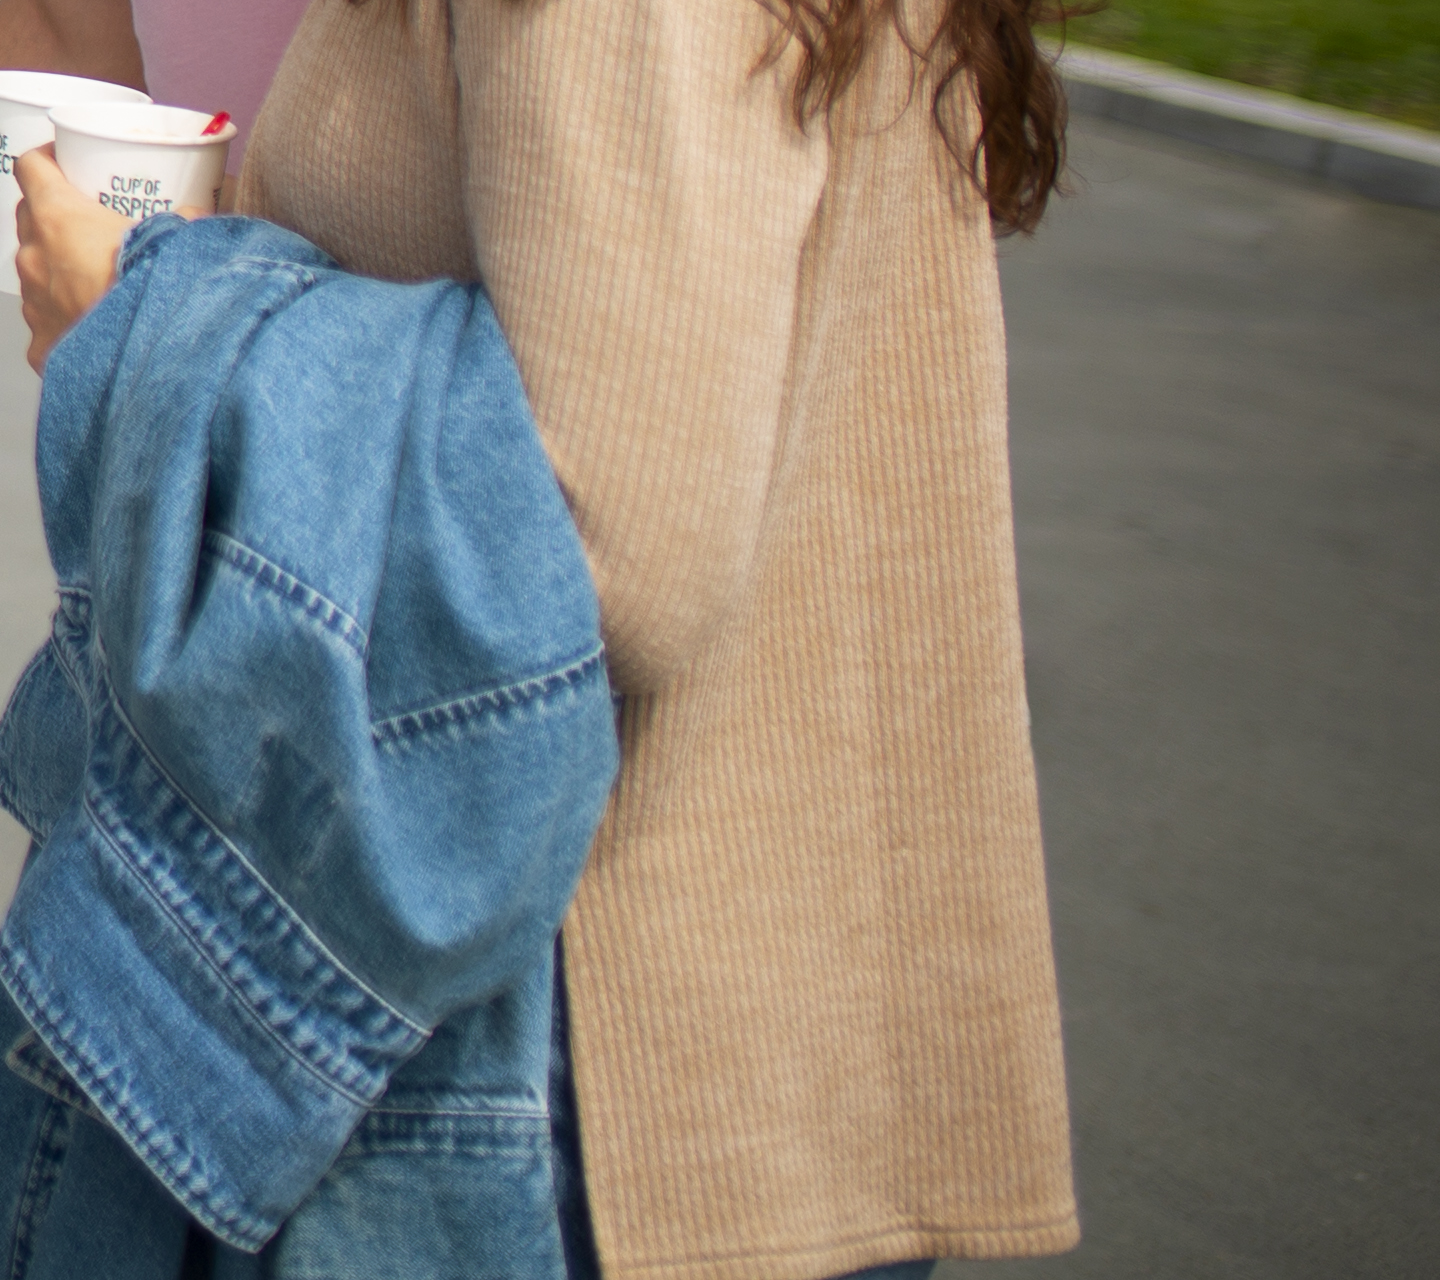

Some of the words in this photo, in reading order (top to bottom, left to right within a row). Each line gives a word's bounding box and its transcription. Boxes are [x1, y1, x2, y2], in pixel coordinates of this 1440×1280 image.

[111, 175, 142, 195] CUP
[144, 179, 162, 196] OF
[98, 191, 173, 219] RESPECT
